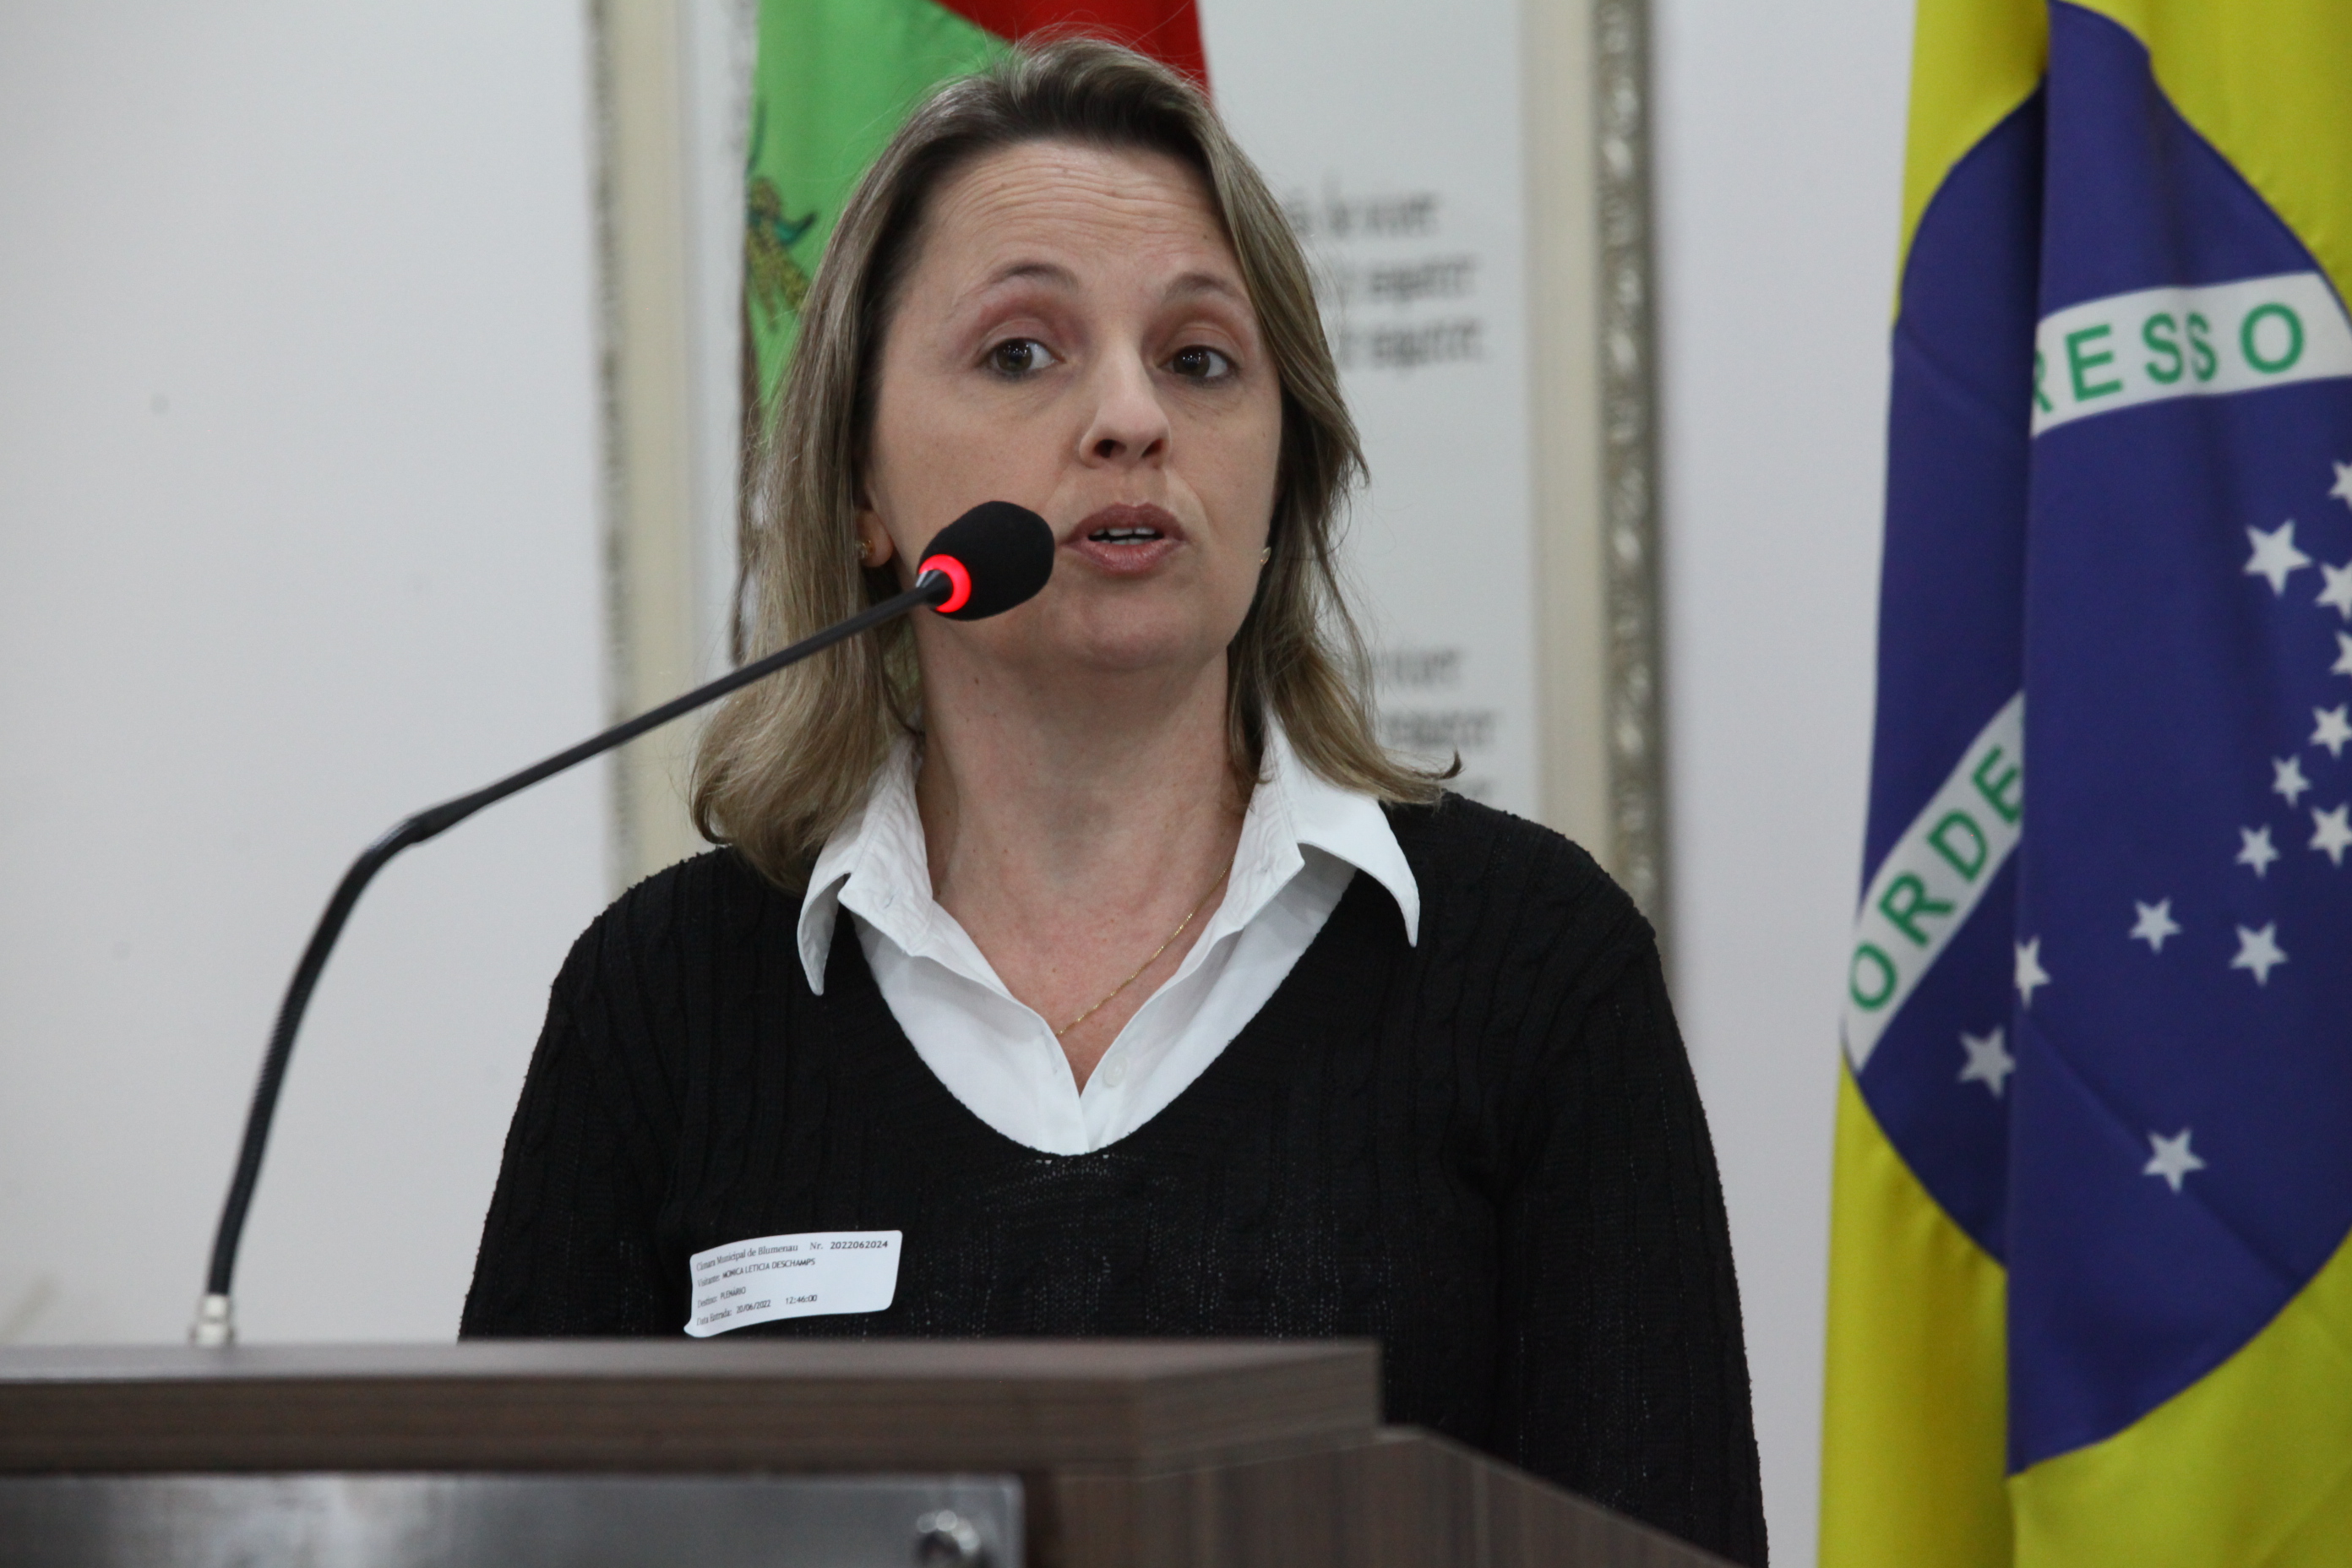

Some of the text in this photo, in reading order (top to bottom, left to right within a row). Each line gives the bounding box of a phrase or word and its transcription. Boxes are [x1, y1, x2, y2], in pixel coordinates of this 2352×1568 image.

[716, 1250, 746, 1265] Municipal
[747, 1248, 757, 1257] de
[758, 1244, 798, 1255] Blumenau
[809, 1242, 824, 1250] Nr.
[830, 1240, 889, 1250] 2022062024
[697, 1274, 721, 1288] Visitante:
[745, 1262, 770, 1274] LETICIA
[771, 1258, 815, 1270] DESCHAMPS
[696, 1294, 818, 1326] Data Entrada: 20/06/2022 12:46:00
[697, 1286, 747, 1309] Destino: PLENÁRIO
